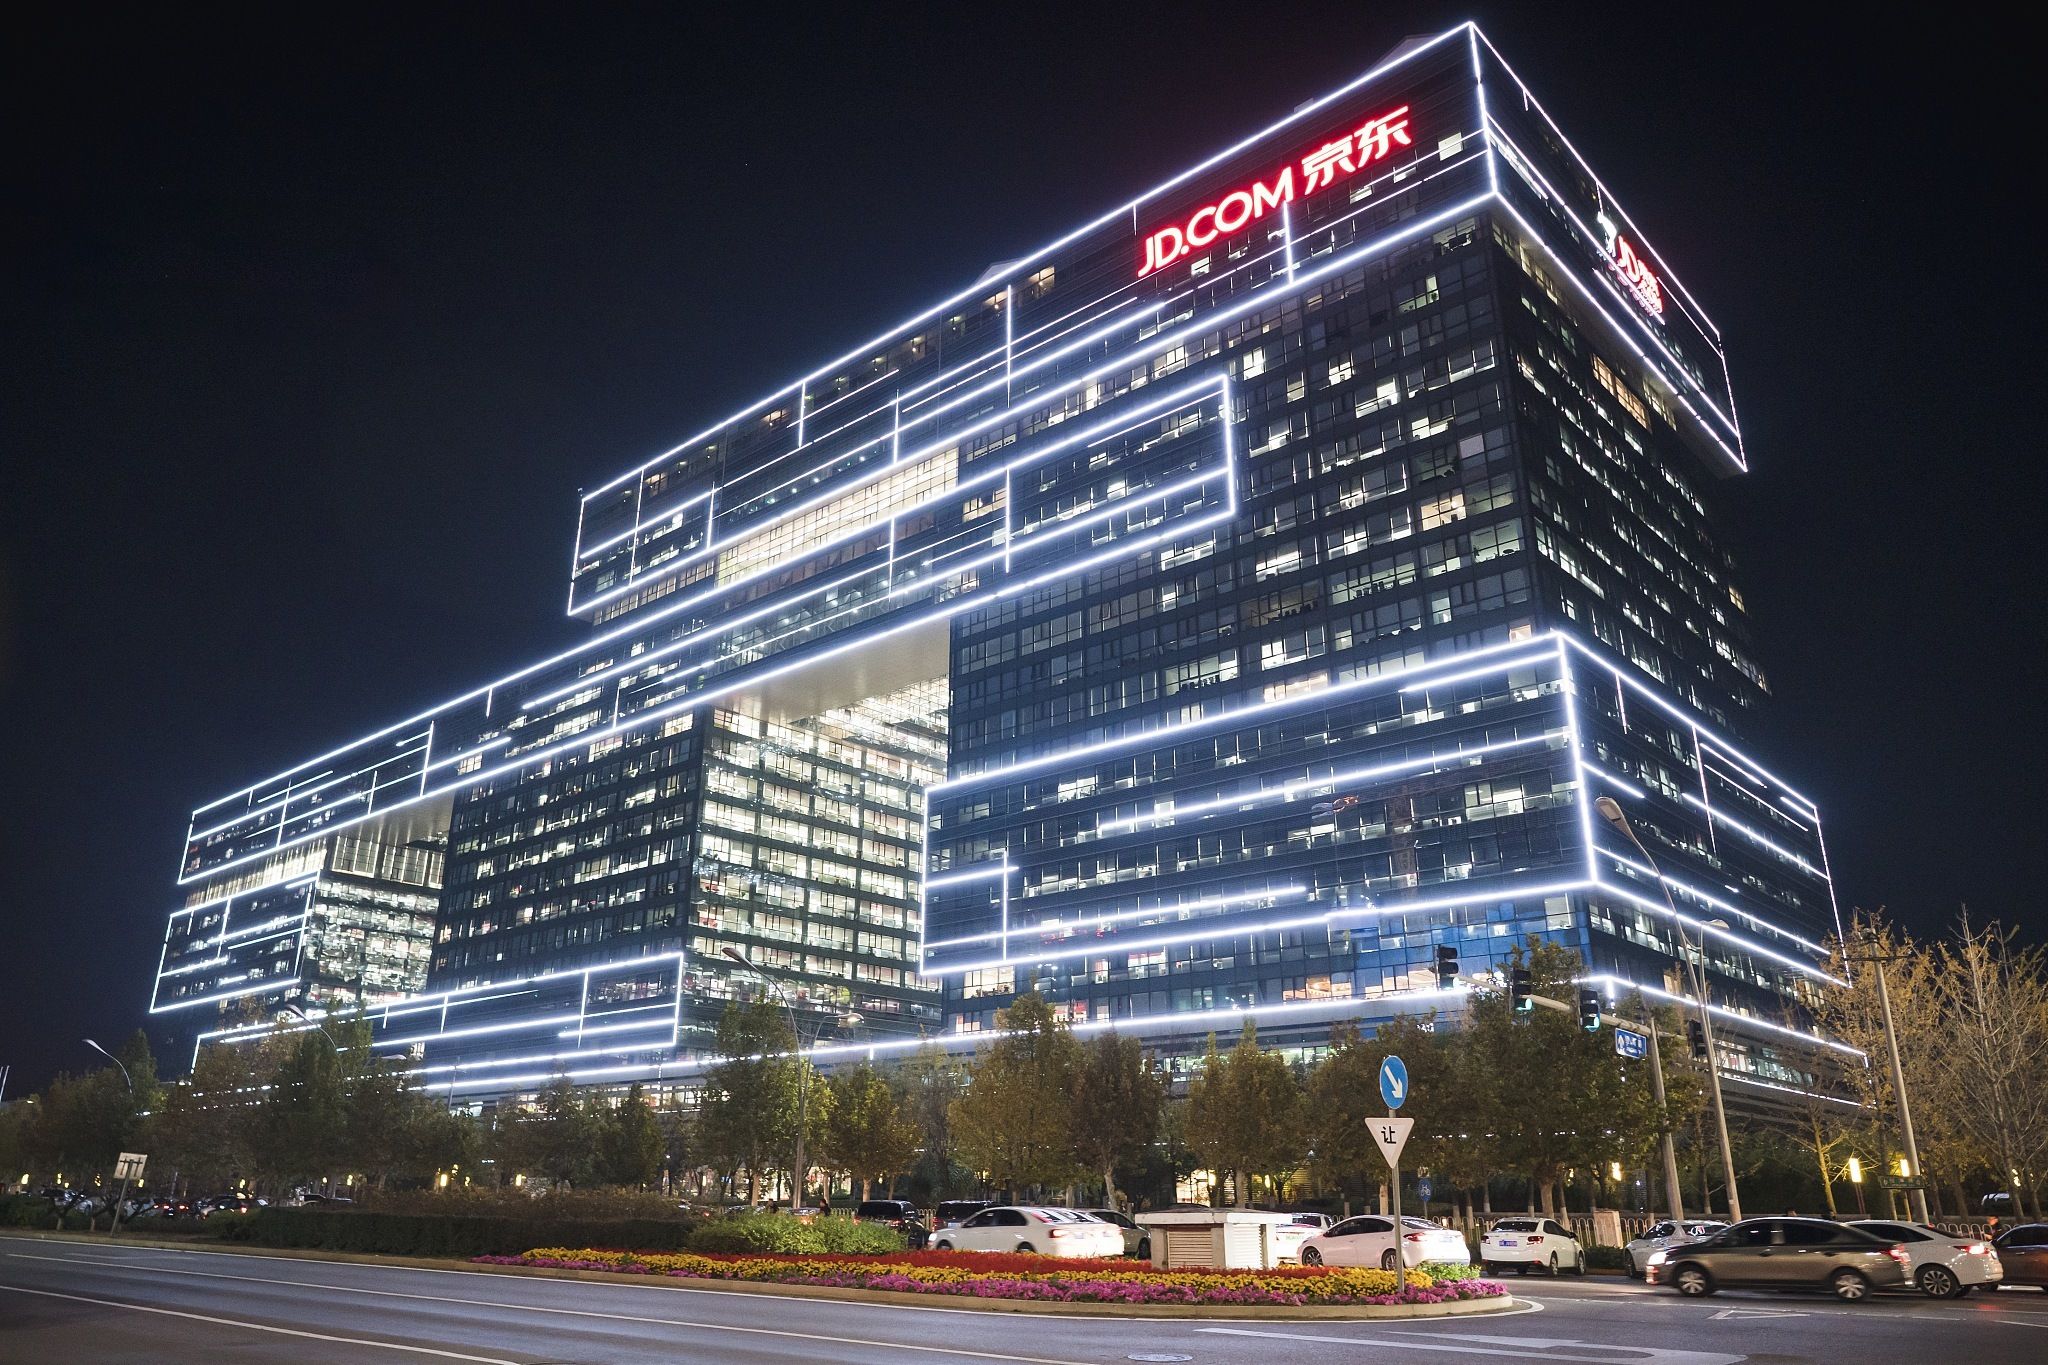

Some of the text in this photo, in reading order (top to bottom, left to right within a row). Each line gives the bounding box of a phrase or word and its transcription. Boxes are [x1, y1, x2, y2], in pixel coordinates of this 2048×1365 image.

[1137, 105, 1412, 278] JD.COM 京东
[1380, 1125, 1397, 1145] 让
